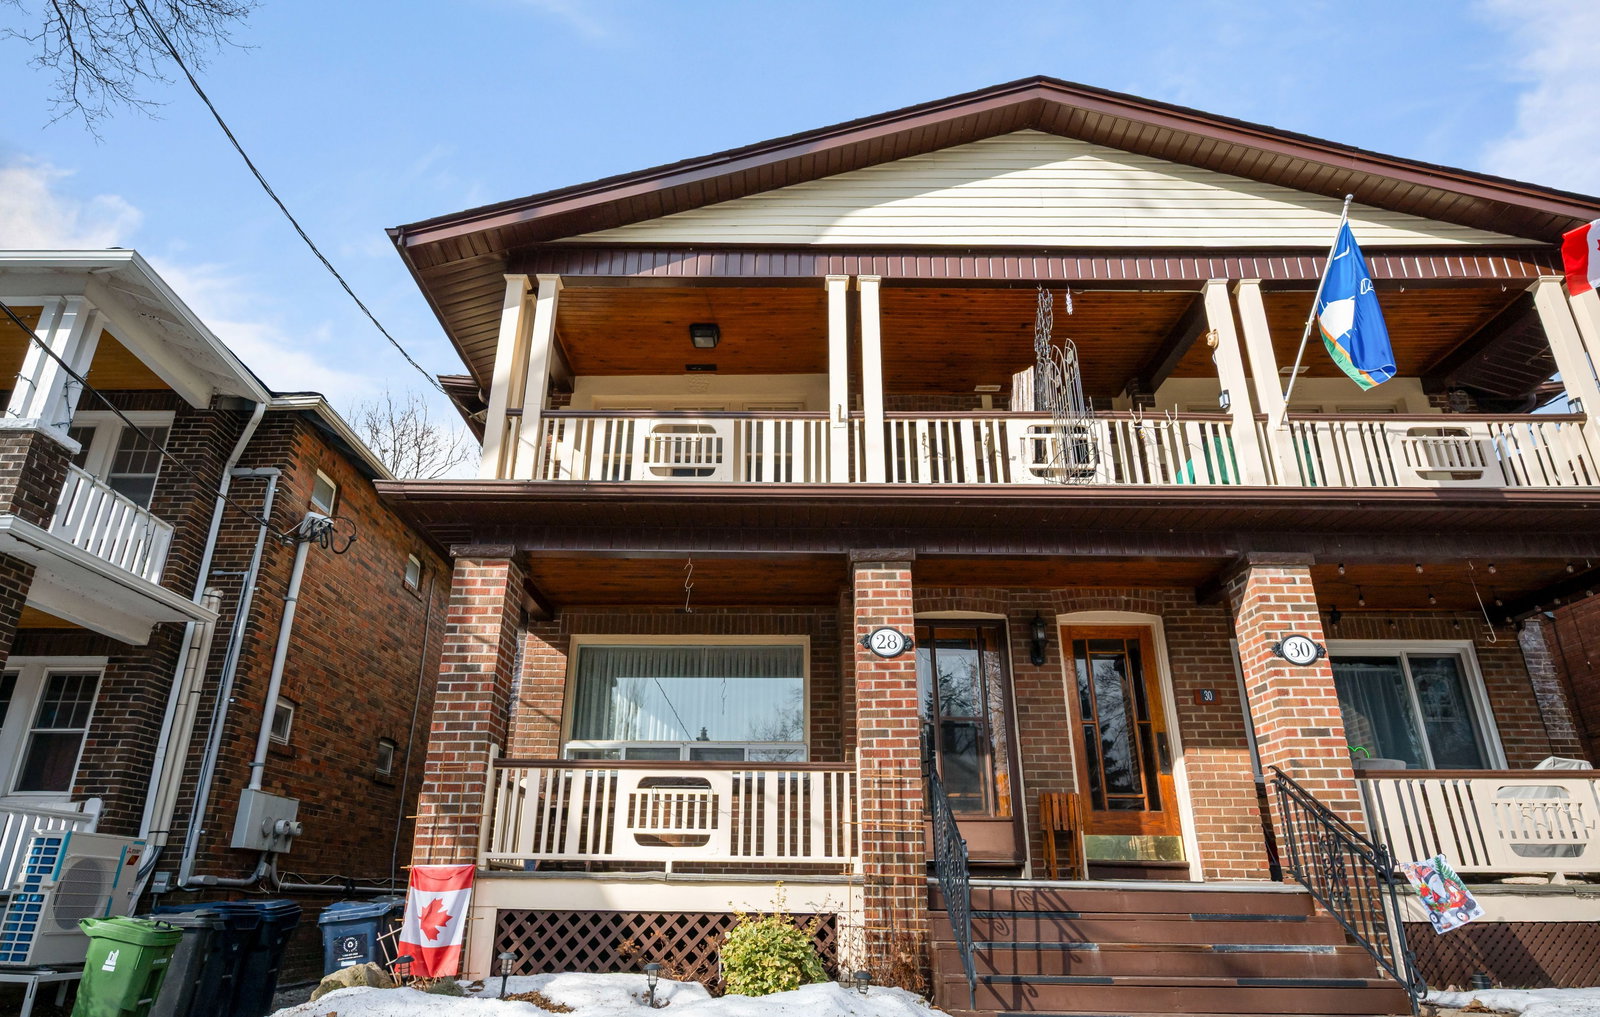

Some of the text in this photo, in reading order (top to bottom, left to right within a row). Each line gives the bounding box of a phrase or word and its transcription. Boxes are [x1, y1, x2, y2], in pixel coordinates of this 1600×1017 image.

[876, 634, 898, 650] 28
[1289, 641, 1310, 658] 30
[1203, 690, 1213, 701] 30
